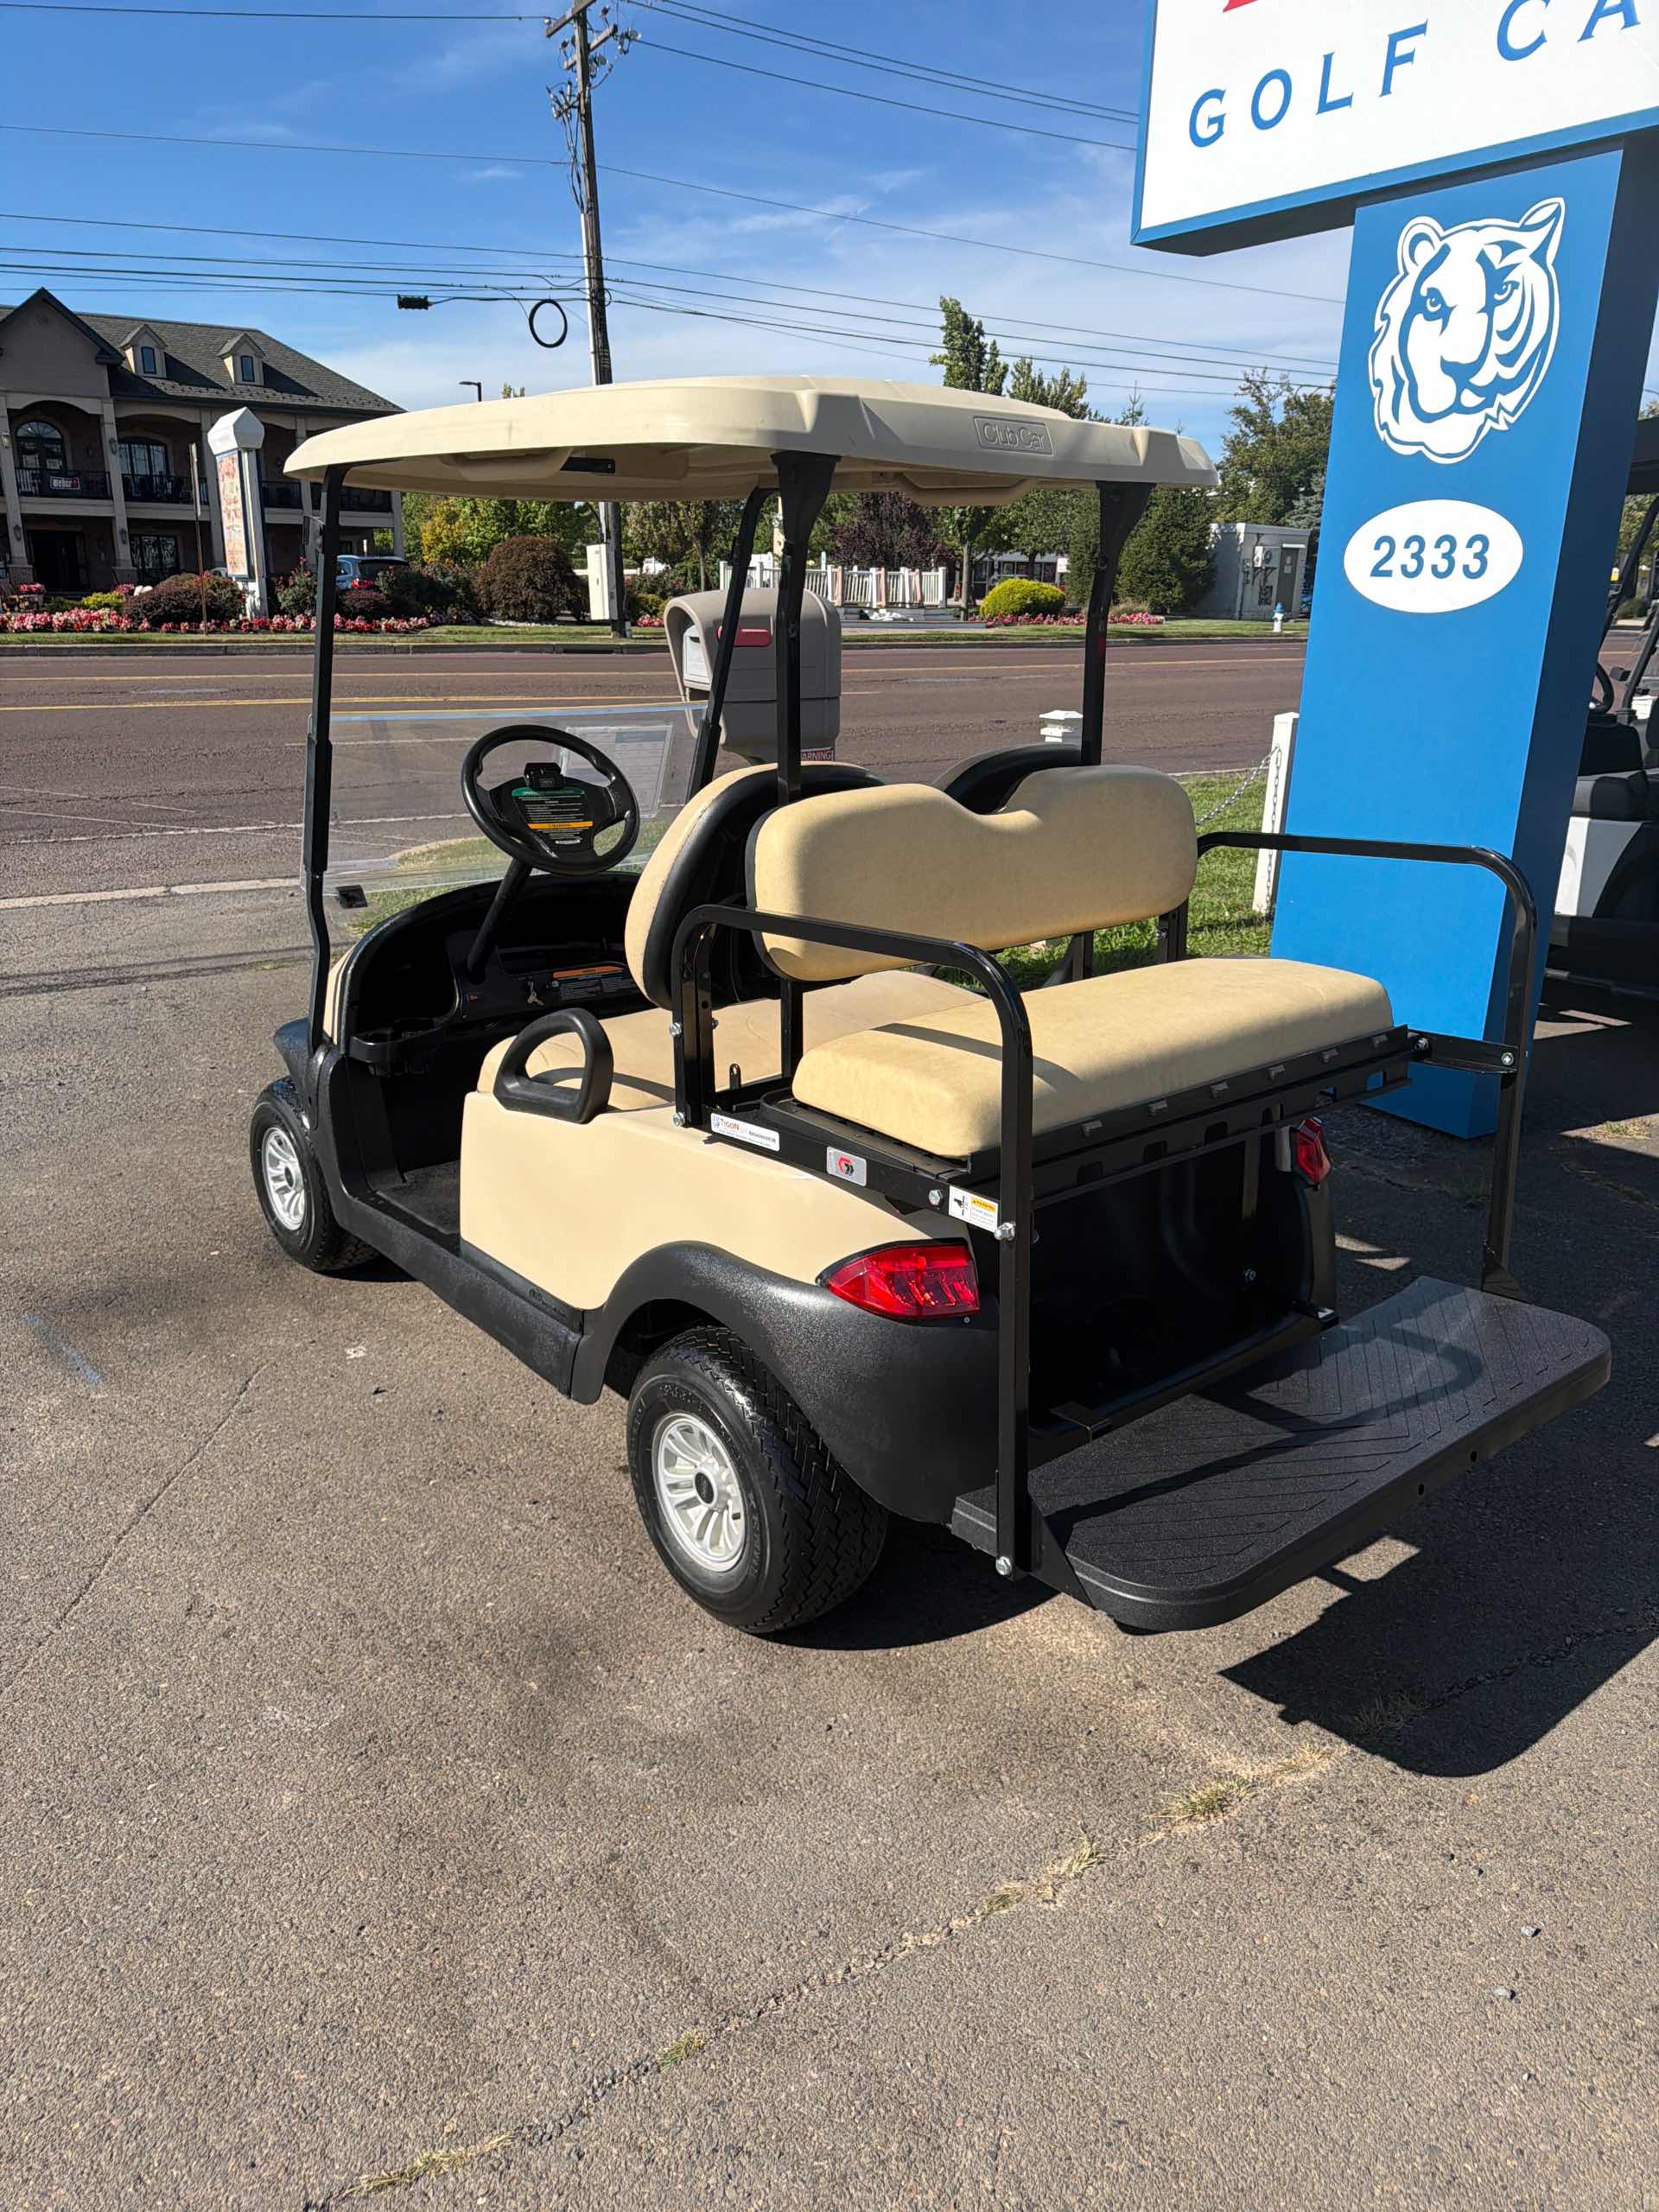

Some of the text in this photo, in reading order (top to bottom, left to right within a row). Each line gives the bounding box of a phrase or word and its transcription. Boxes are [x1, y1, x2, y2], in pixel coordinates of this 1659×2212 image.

[1189, 18, 1428, 148] GOLF
[983, 422, 1045, 450] Club Car
[1370, 533, 1490, 579] 2333
[801, 751, 830, 761] ARNING
